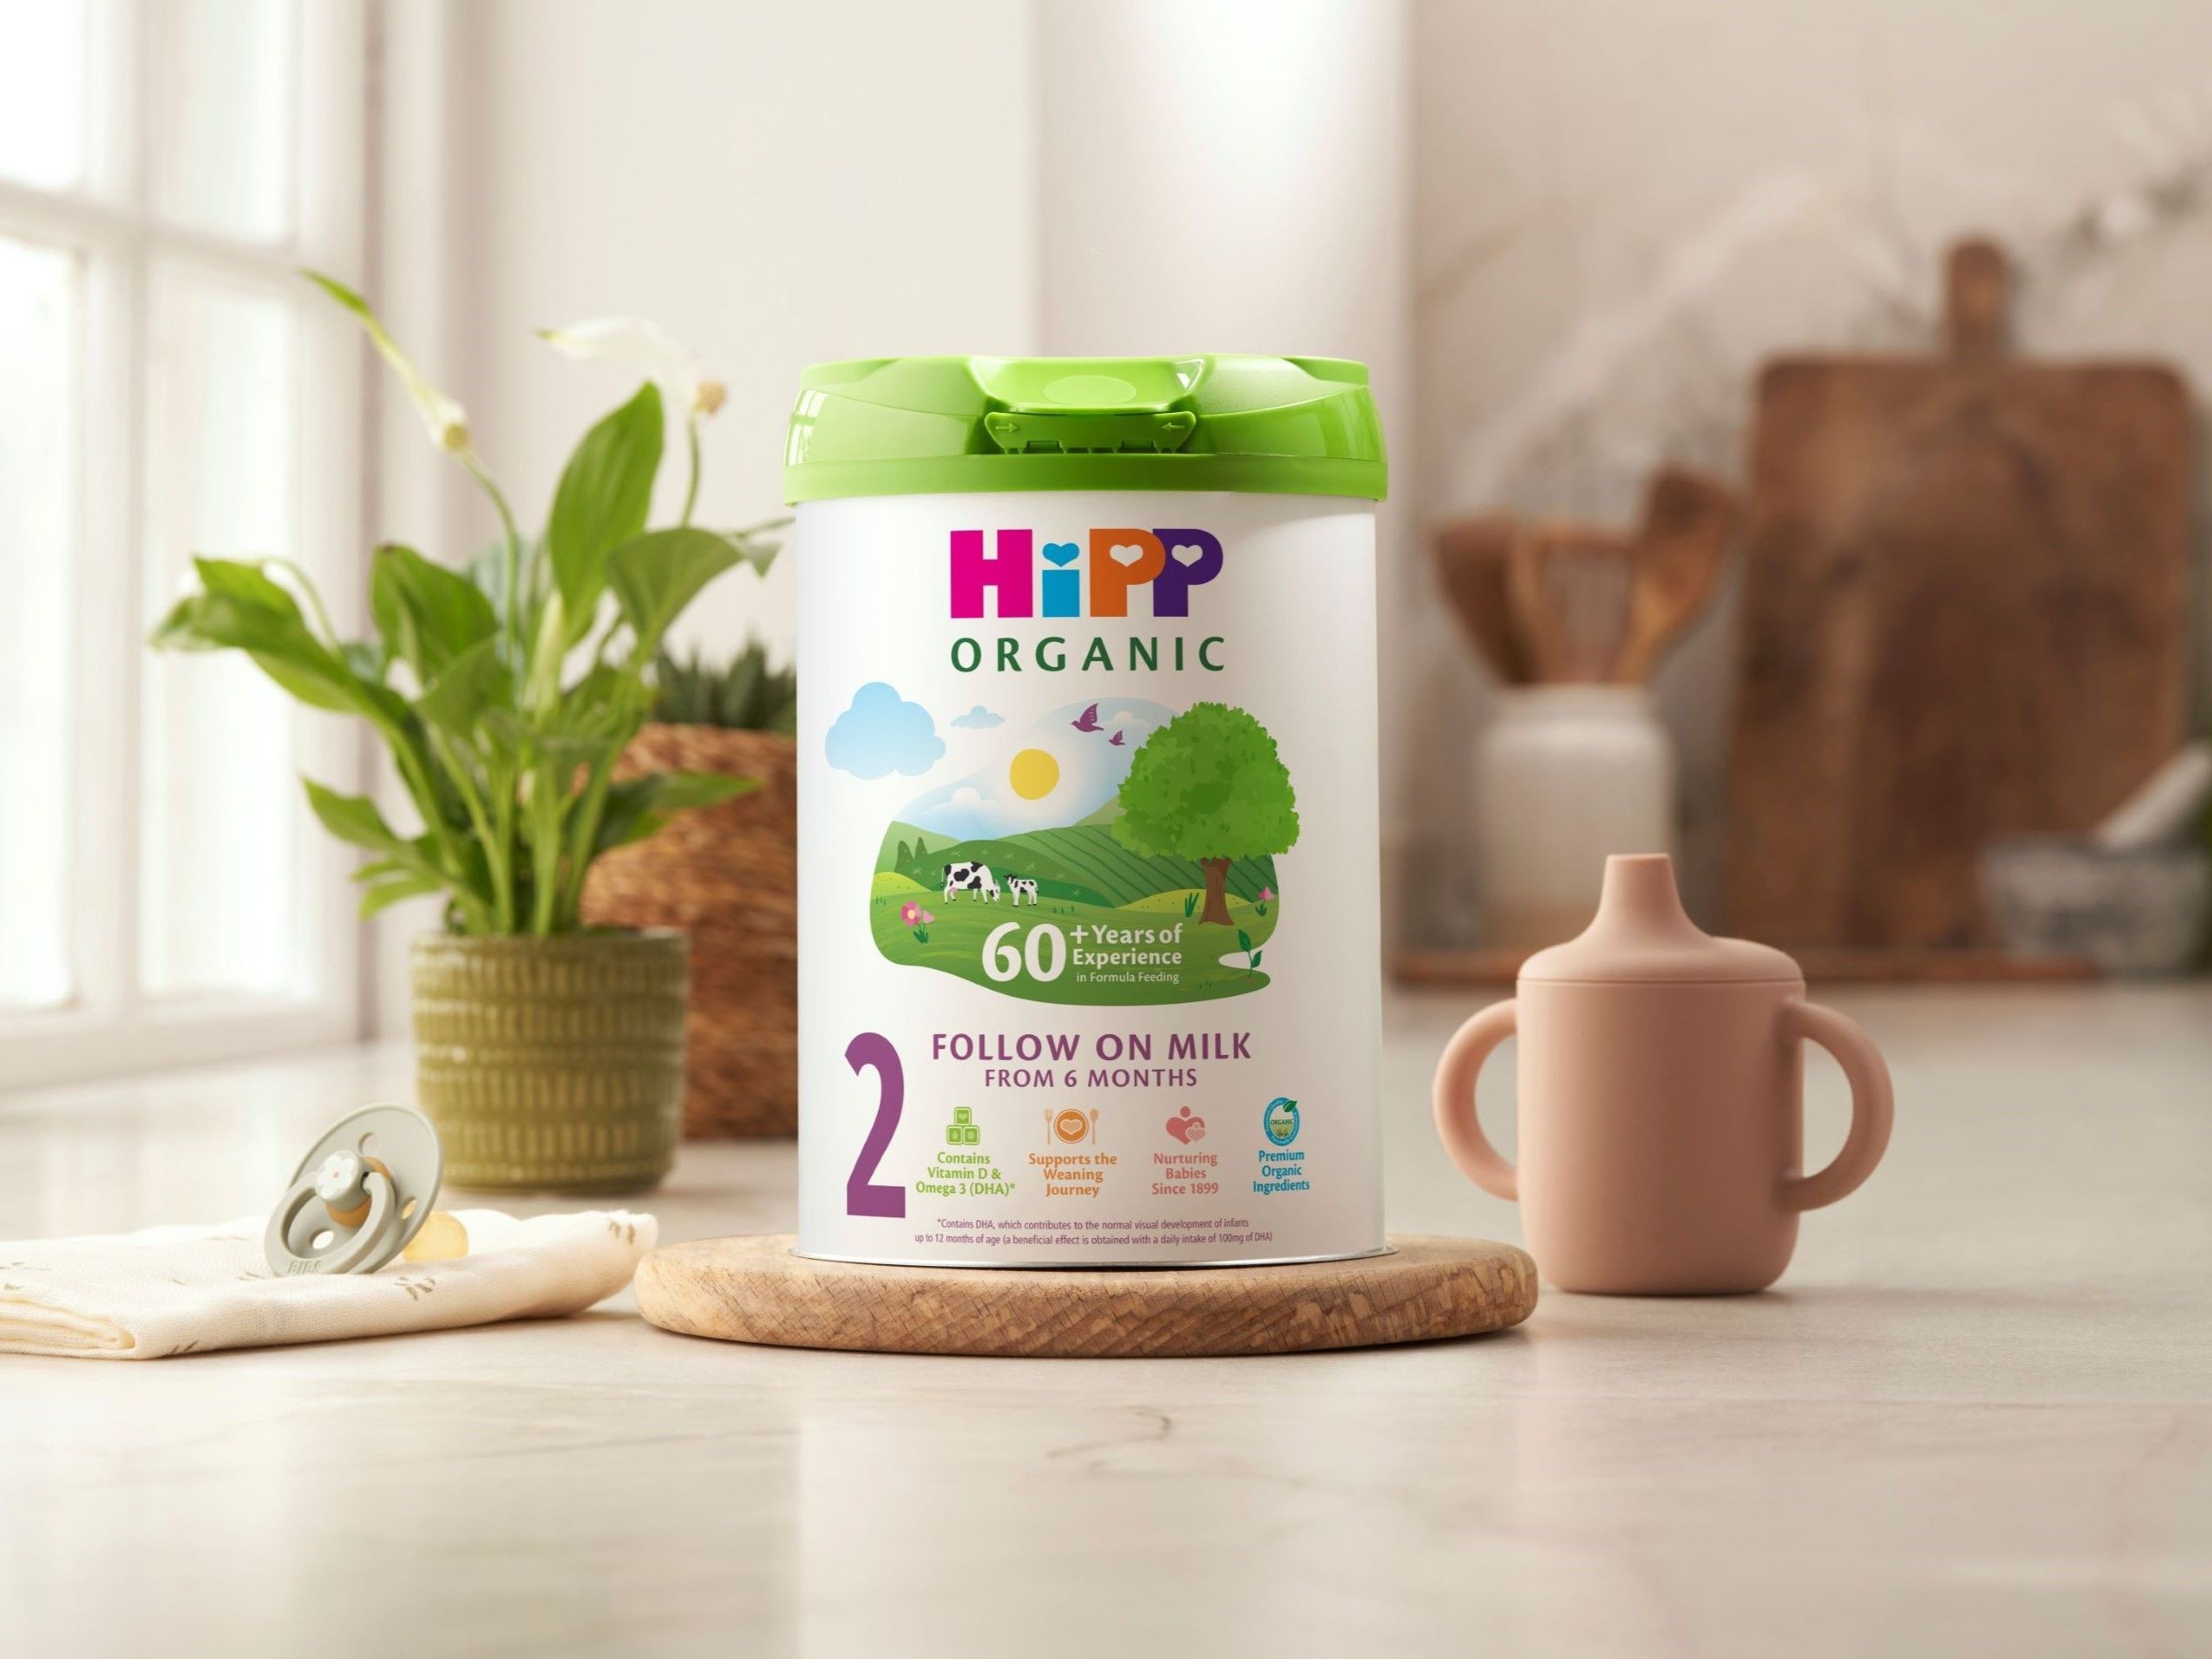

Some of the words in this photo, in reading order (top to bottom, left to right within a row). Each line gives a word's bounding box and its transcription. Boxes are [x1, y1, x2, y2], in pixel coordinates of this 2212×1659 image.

[950, 528, 1224, 619] HiPP
[950, 636, 1224, 672] ORGANIC
[1091, 925, 1154, 944] Years
[1159, 923, 1183, 944] of
[1072, 948, 1182, 970] Experience
[1076, 972, 1087, 982] in
[1090, 972, 1135, 982] Formula
[1138, 972, 1179, 985] Feeding
[932, 1033, 1080, 1061] FOLLOW
[1096, 1033, 1152, 1061] ON
[1168, 1033, 1252, 1059] MILK
[984, 1069, 1054, 1087] FROM
[1064, 1069, 1077, 1087] 6
[1088, 1068, 1198, 1087] MONTHS
[844, 1032, 906, 1218] 2
[937, 1152, 990, 1164] Contains
[1028, 1154, 1090, 1167] Supports
[1095, 1153, 1117, 1165] the
[1154, 1152, 1217, 1166] Nurturing
[1258, 1149, 1305, 1161] Premium
[927, 1167, 974, 1179] Vitamin
[978, 1168, 988, 1179] D
[991, 1168, 1001, 1179] &
[1043, 1168, 1103, 1183] Weaning
[1166, 1167, 1206, 1179] Babies
[1262, 1164, 1302, 1179] Organic
[916, 1182, 956, 1197] Omega
[959, 1183, 966, 1194] 3
[1046, 1184, 1100, 1198] Journey
[1152, 1183, 1186, 1195] Since
[1190, 1183, 1219, 1194] 1899
[1253, 1179, 1310, 1195] Ingredients
[976, 1220, 995, 1230] DHA,
[998, 1220, 1022, 1230] which
[1024, 1220, 1071, 1230] contributes
[1085, 1221, 1099, 1230] the
[1102, 1220, 1132, 1230] normal
[1135, 1220, 1158, 1230] visual
[1161, 1219, 1212, 1230] development
[1214, 1218, 1223, 1228] of
[1224, 1217, 1249, 1227] infants
[915, 1235, 924, 1243] up
[935, 1234, 944, 1243] 12
[945, 1234, 973, 1243] months
[976, 1235, 984, 1243] of
[986, 1236, 1001, 1246] age
[1003, 1235, 1011, 1245] (a
[1013, 1235, 1052, 1244] beneficial
[1055, 1235, 1080, 1244] effect
[1082, 1235, 1089, 1244] is
[1091, 1235, 1129, 1244] obtained
[1131, 1235, 1151, 1244] with
[1161, 1234, 1179, 1246] daily
[1182, 1234, 1205, 1243] intake
[1208, 1233, 1216, 1243] of
[1218, 1234, 1243, 1244] 100mg
[1246, 1232, 1253, 1242] of
[1255, 1231, 1273, 1243] DHA)
